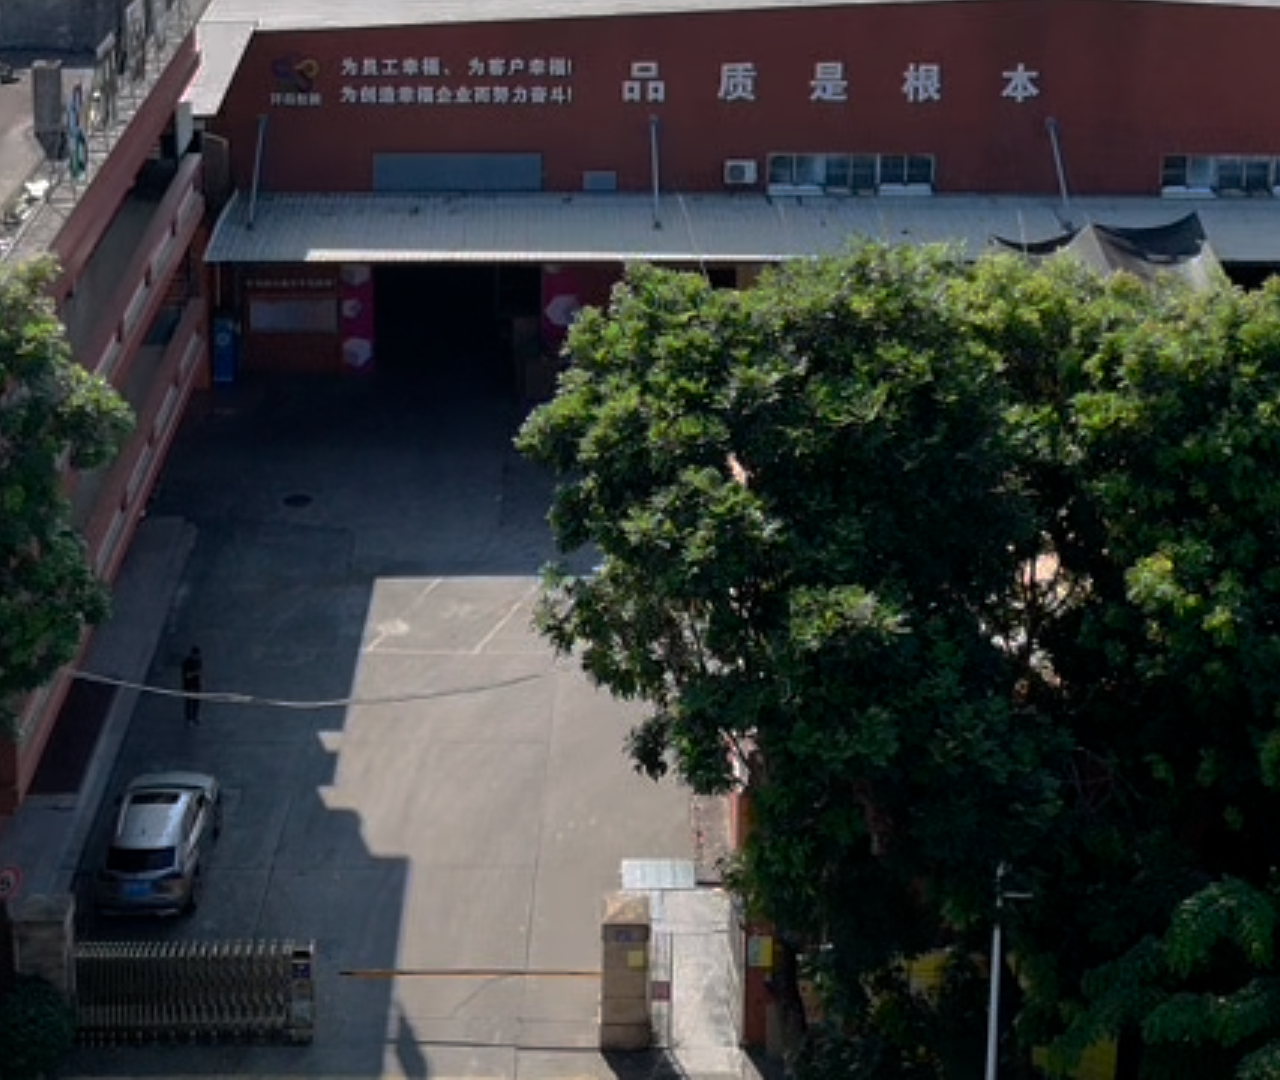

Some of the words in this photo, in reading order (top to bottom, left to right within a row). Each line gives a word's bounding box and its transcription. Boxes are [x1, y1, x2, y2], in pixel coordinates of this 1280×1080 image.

[621, 61, 1040, 103] 品质是根本
